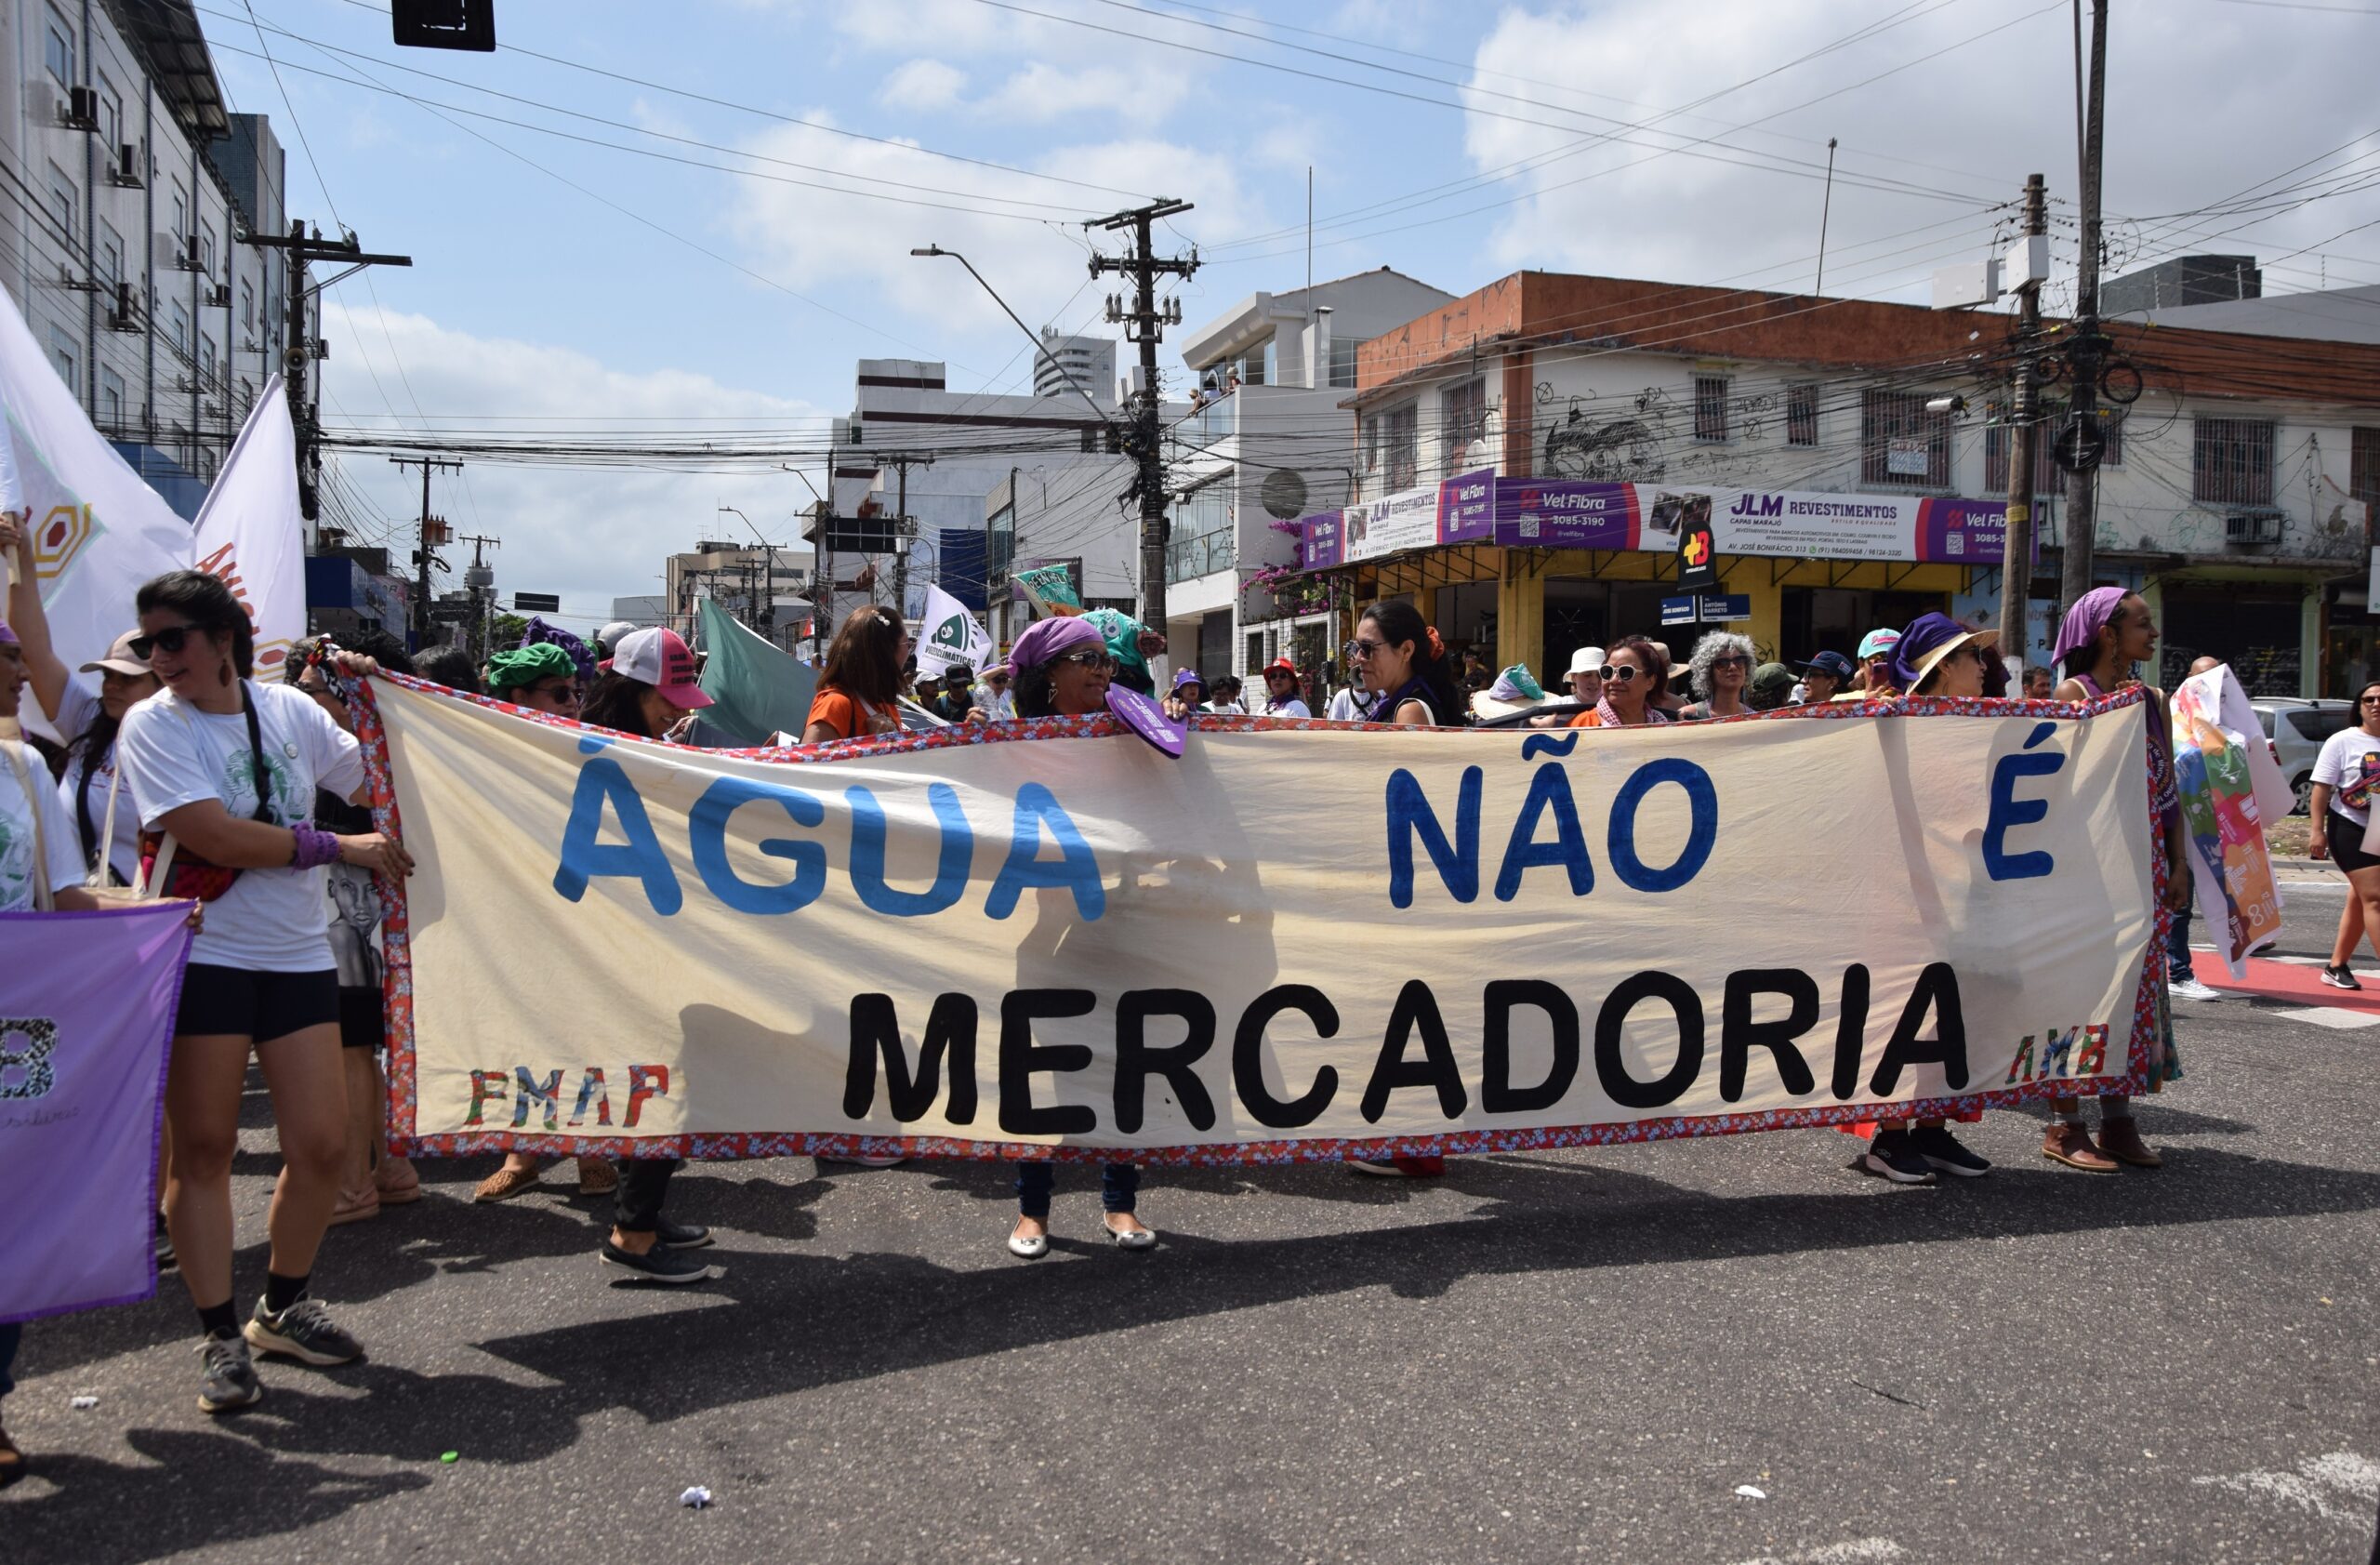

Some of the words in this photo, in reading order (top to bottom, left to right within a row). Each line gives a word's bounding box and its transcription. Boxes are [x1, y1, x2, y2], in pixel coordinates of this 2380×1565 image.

[1543, 493, 1565, 509] Vel
[1567, 494, 1606, 510] Fibra
[1731, 493, 1784, 517] JLM
[1790, 501, 1897, 519] REVESTIMENTOS
[1370, 500, 1390, 524] JLM
[1553, 515, 1605, 526] 3085-3190
[1753, 518, 1781, 526] MARAJÓ
[1966, 512, 1986, 527] Vel
[1988, 513, 2007, 527] Fib
[1740, 542, 1755, 550] JOSÉ
[1975, 534, 2005, 543] 3085-3
[552, 735, 1106, 922] ÁGUA
[1385, 730, 1718, 909] NÃO
[1982, 723, 2066, 882] É
[843, 962, 1970, 1135] MERCADORIA
[2005, 1023, 2109, 1085] AMB
[463, 1065, 669, 1131] FMAP
